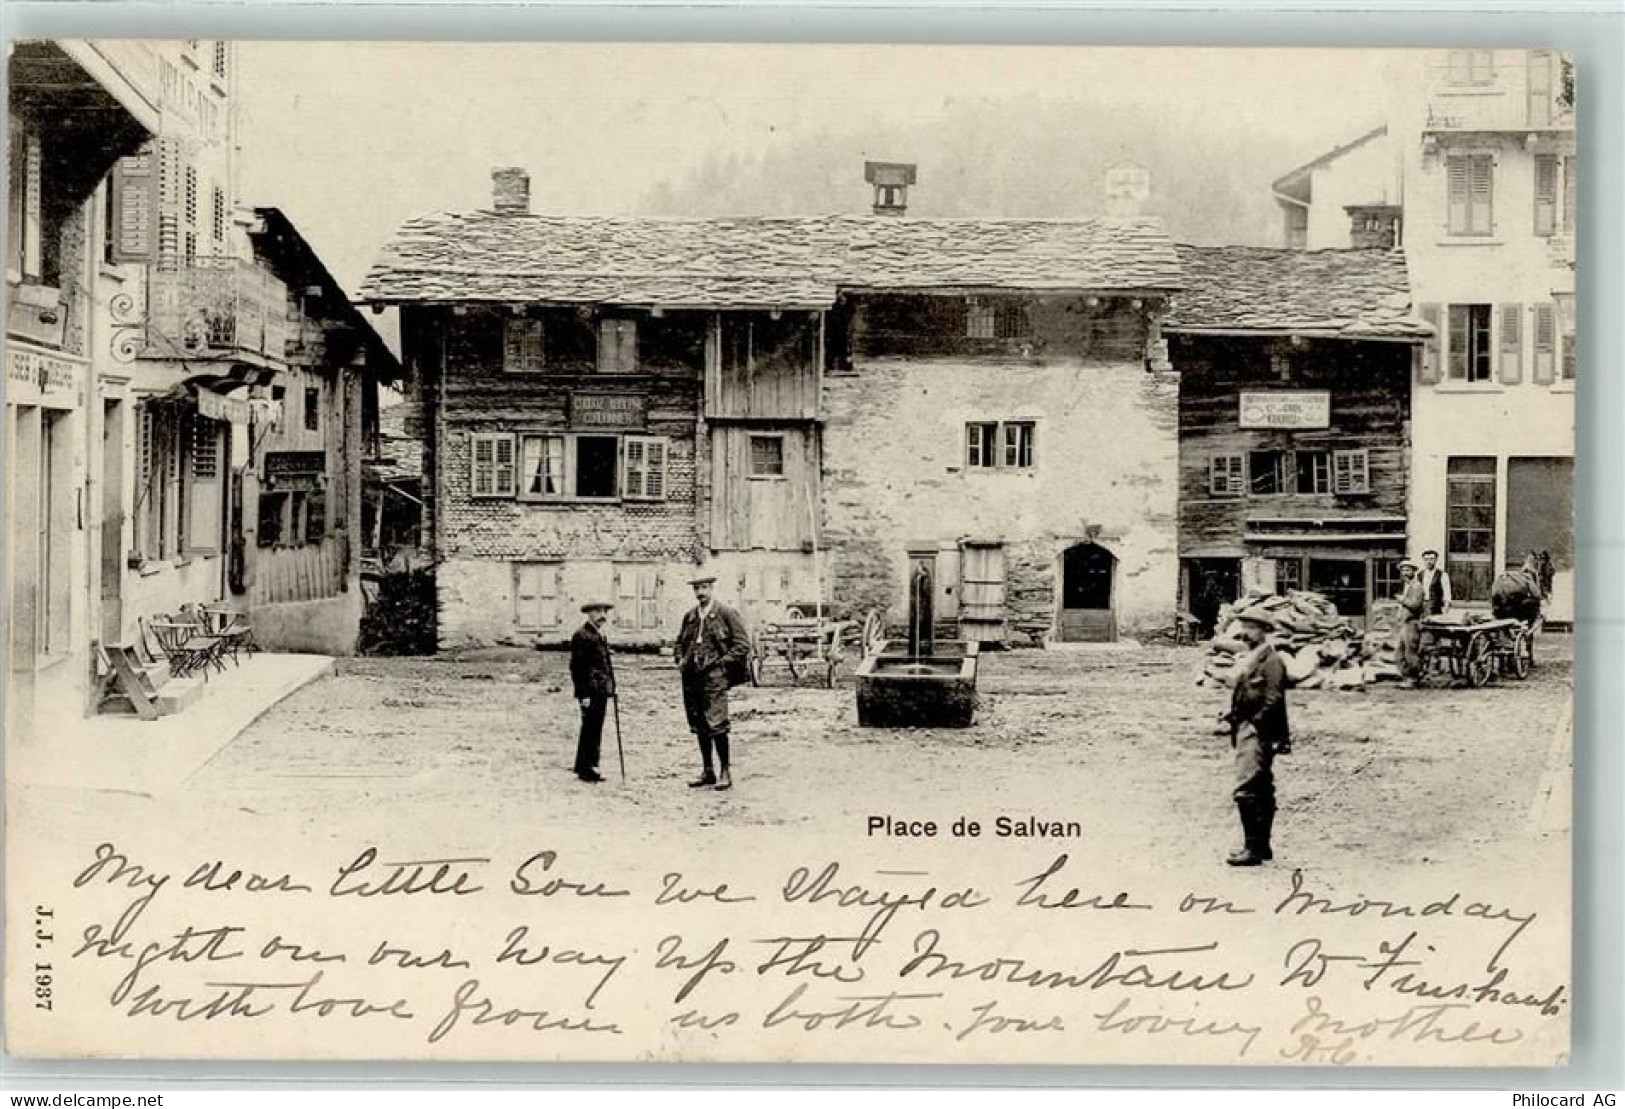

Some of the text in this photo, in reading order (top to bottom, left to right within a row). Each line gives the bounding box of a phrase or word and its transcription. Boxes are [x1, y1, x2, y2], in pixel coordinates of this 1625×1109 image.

[72, 843, 170, 943] My
[183, 861, 312, 893] dear
[329, 847, 491, 897] little
[510, 850, 631, 897] Son
[1015, 854, 1153, 910] here
[1178, 893, 1255, 914] on
[1274, 868, 1537, 974] Monday
[259, 936, 346, 963] on
[368, 941, 470, 969] our
[288, 970, 414, 1019] love
[427, 979, 624, 1044] from
[670, 1009, 740, 1030] us
